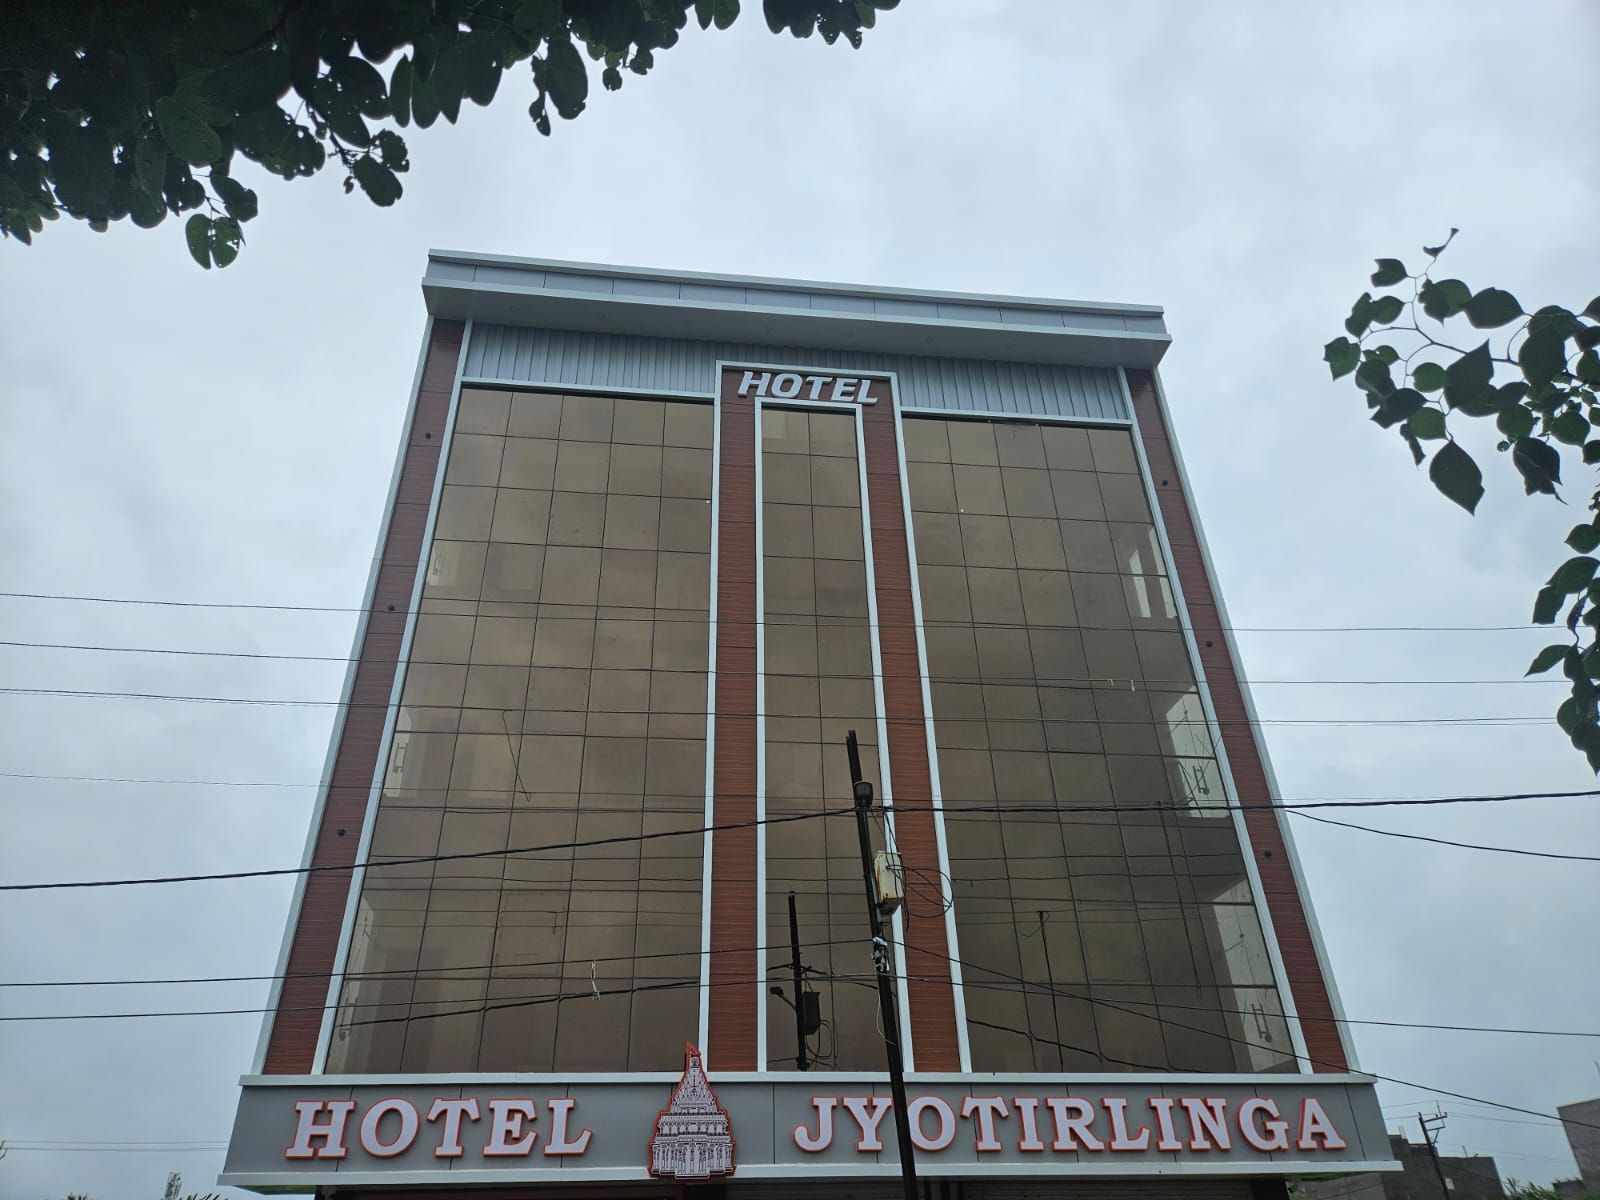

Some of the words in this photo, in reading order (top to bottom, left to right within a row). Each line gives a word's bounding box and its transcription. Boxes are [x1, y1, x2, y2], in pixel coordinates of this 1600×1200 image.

[737, 371, 878, 404] HOTEL
[285, 1098, 592, 1158] HOTEL
[793, 1096, 1346, 1152] JYOTIRLINGA
